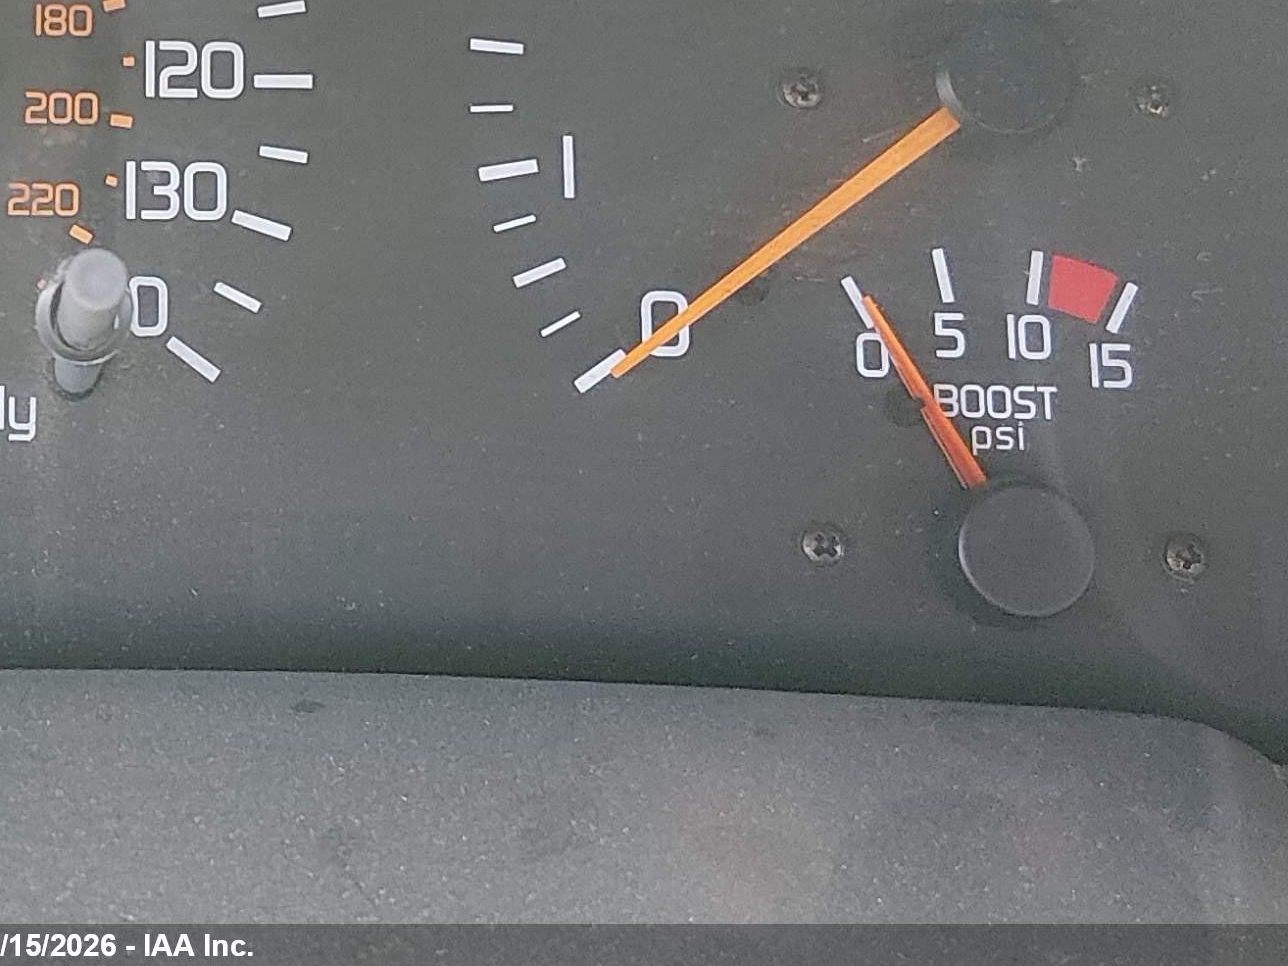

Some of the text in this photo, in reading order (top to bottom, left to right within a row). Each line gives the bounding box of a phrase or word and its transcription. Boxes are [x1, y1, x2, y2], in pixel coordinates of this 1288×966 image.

[35, 3, 93, 37] 180
[145, 40, 244, 99] 120
[25, 91, 99, 125] 200
[562, 135, 575, 199] 1
[7, 182, 79, 216] 220
[125, 160, 227, 221] 130
[639, 290, 691, 358] 0
[934, 312, 966, 358] 5
[1006, 313, 1052, 360] 10
[855, 332, 890, 378] 0
[1089, 343, 1133, 389] 15
[933, 384, 1058, 420] BOOST
[970, 420, 1025, 456] psi
